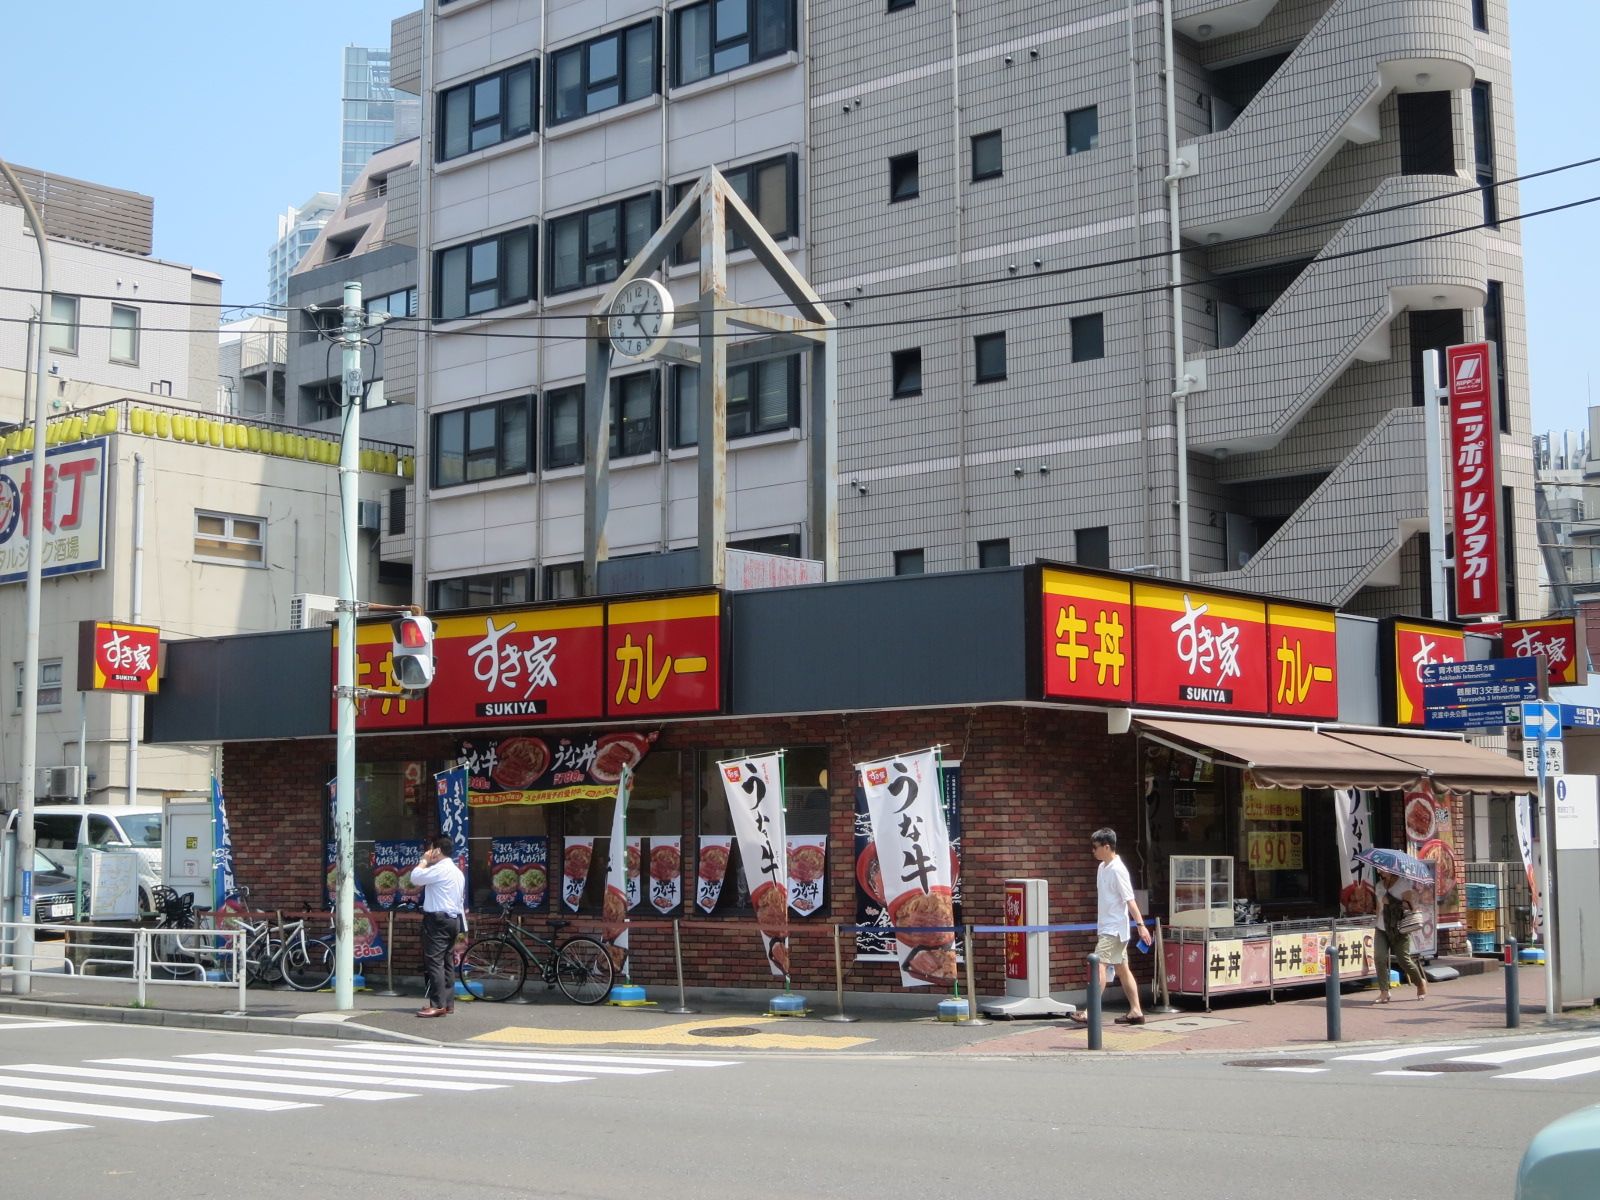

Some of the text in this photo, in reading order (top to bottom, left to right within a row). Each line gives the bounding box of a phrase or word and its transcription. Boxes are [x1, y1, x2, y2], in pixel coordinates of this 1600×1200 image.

[653, 296, 658, 306] 2
[616, 319, 622, 329] 9
[653, 324, 658, 334] 4
[627, 340, 632, 351] 7
[636, 341, 642, 352] 6
[1457, 400, 1487, 600] ニッポンレンタカー
[102, 630, 152, 675] すき家
[1055, 604, 1126, 687] 牛丼
[1170, 593, 1241, 687] すき家
[467, 616, 558, 700] すき家
[614, 632, 708, 706] カレー
[1276, 635, 1333, 705] カレー
[115, 674, 138, 682] SUKIYA
[484, 701, 537, 716] SUKIYA
[1185, 686, 1226, 703] SUKIYA
[741, 762, 779, 888] うな牛
[888, 762, 937, 896] うな牛
[1250, 839, 1286, 865] 490
[1209, 950, 1241, 980] 牛丼
[1275, 944, 1302, 972] 牛丼
[1338, 941, 1362, 968] 牛丼
